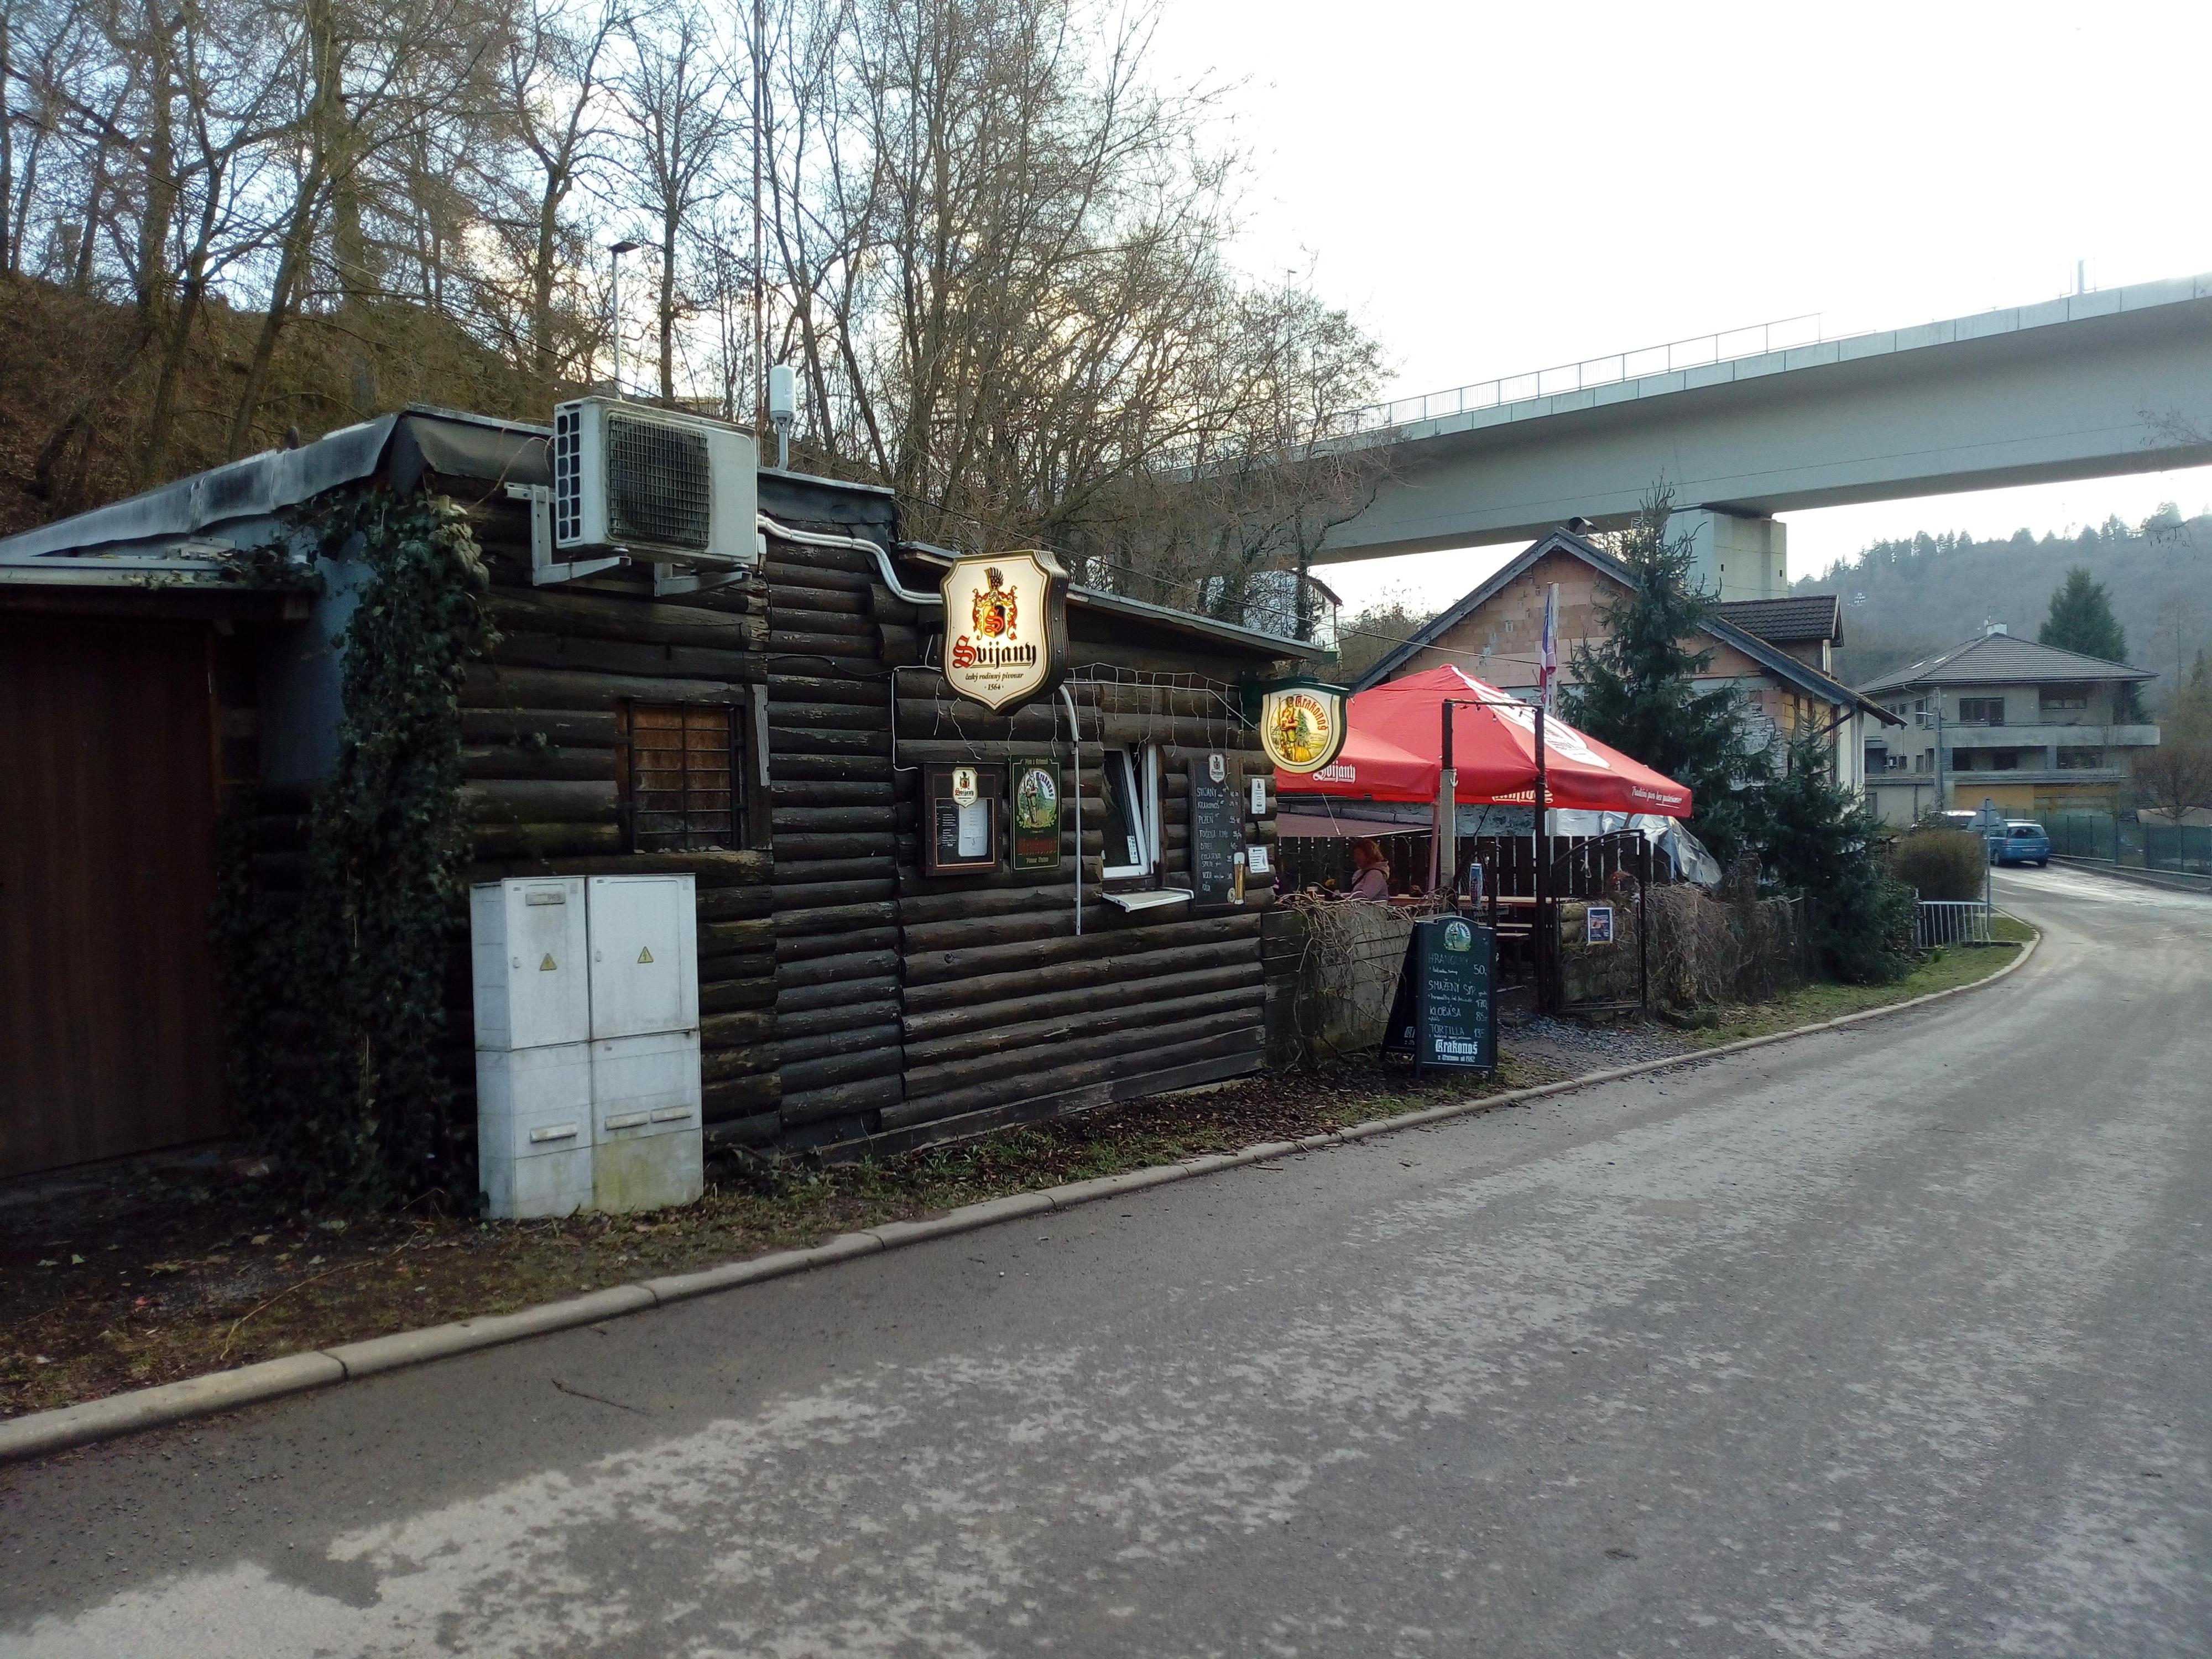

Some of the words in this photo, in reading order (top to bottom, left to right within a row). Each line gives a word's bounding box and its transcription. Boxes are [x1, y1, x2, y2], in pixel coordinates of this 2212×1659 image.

[952, 635, 1036, 669] Svijany
[965, 672, 978, 682] český
[979, 672, 1000, 681] rodinný
[1002, 672, 1024, 681] pivovar
[1430, 1004, 1462, 1018] KLOBÁSA
[1429, 1024, 1465, 1035] TORTILLA
[1435, 1039, 1478, 1055] Krakonoš
